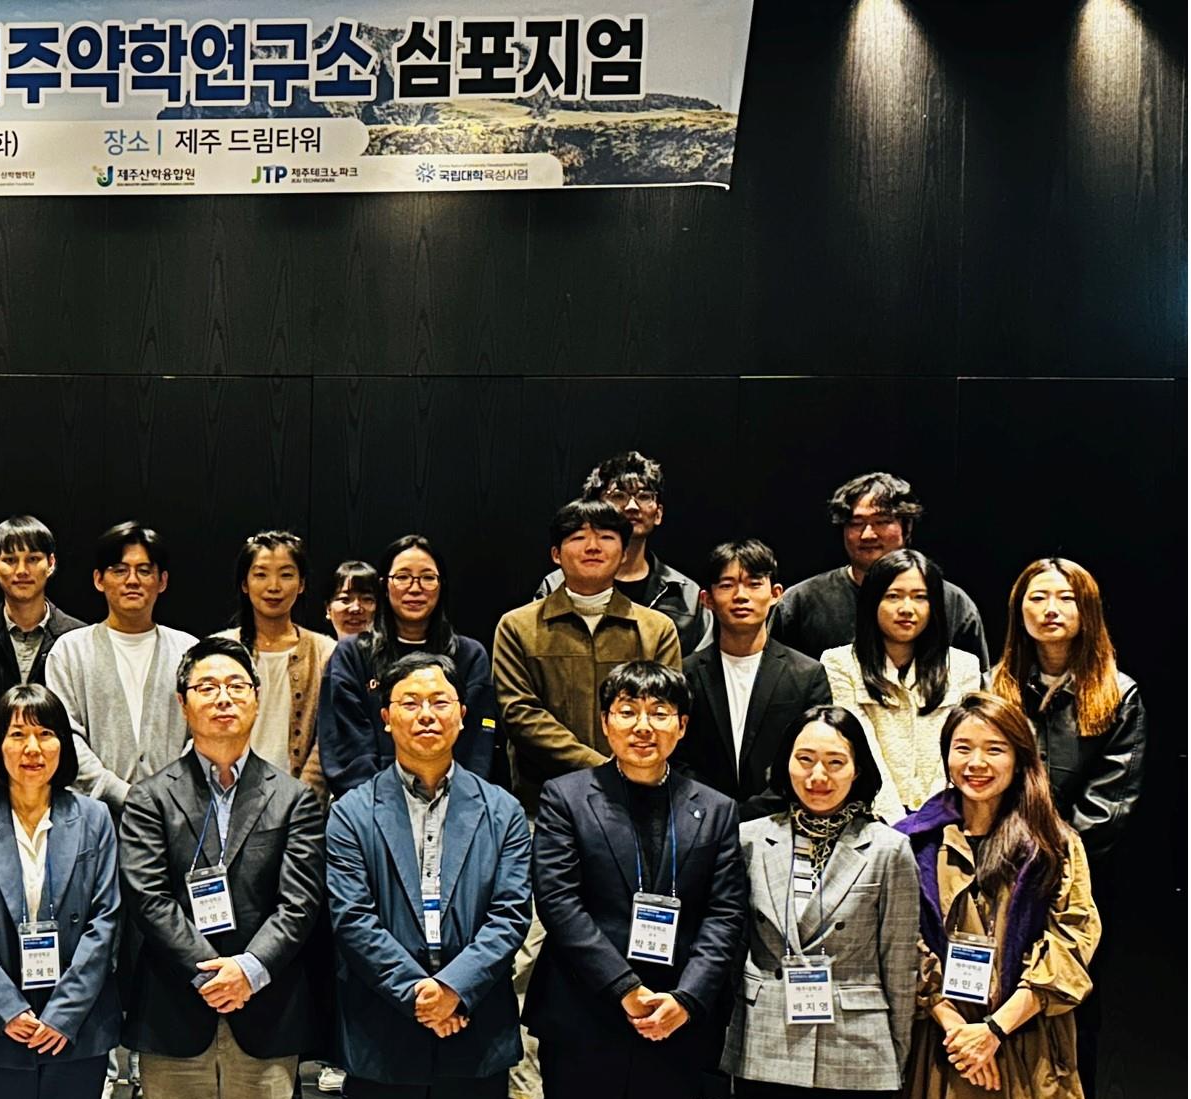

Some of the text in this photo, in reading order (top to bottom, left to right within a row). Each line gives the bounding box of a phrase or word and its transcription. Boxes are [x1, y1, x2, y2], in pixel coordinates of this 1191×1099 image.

[396, 18, 643, 99] 심포지엄
[175, 127, 222, 155] 제주
[228, 126, 321, 155] 드림타워
[117, 168, 195, 181] 제주산학융합원
[251, 166, 288, 184] JTP
[291, 167, 358, 177] 제주테크노파크
[439, 168, 529, 181] 국립대학육성사업
